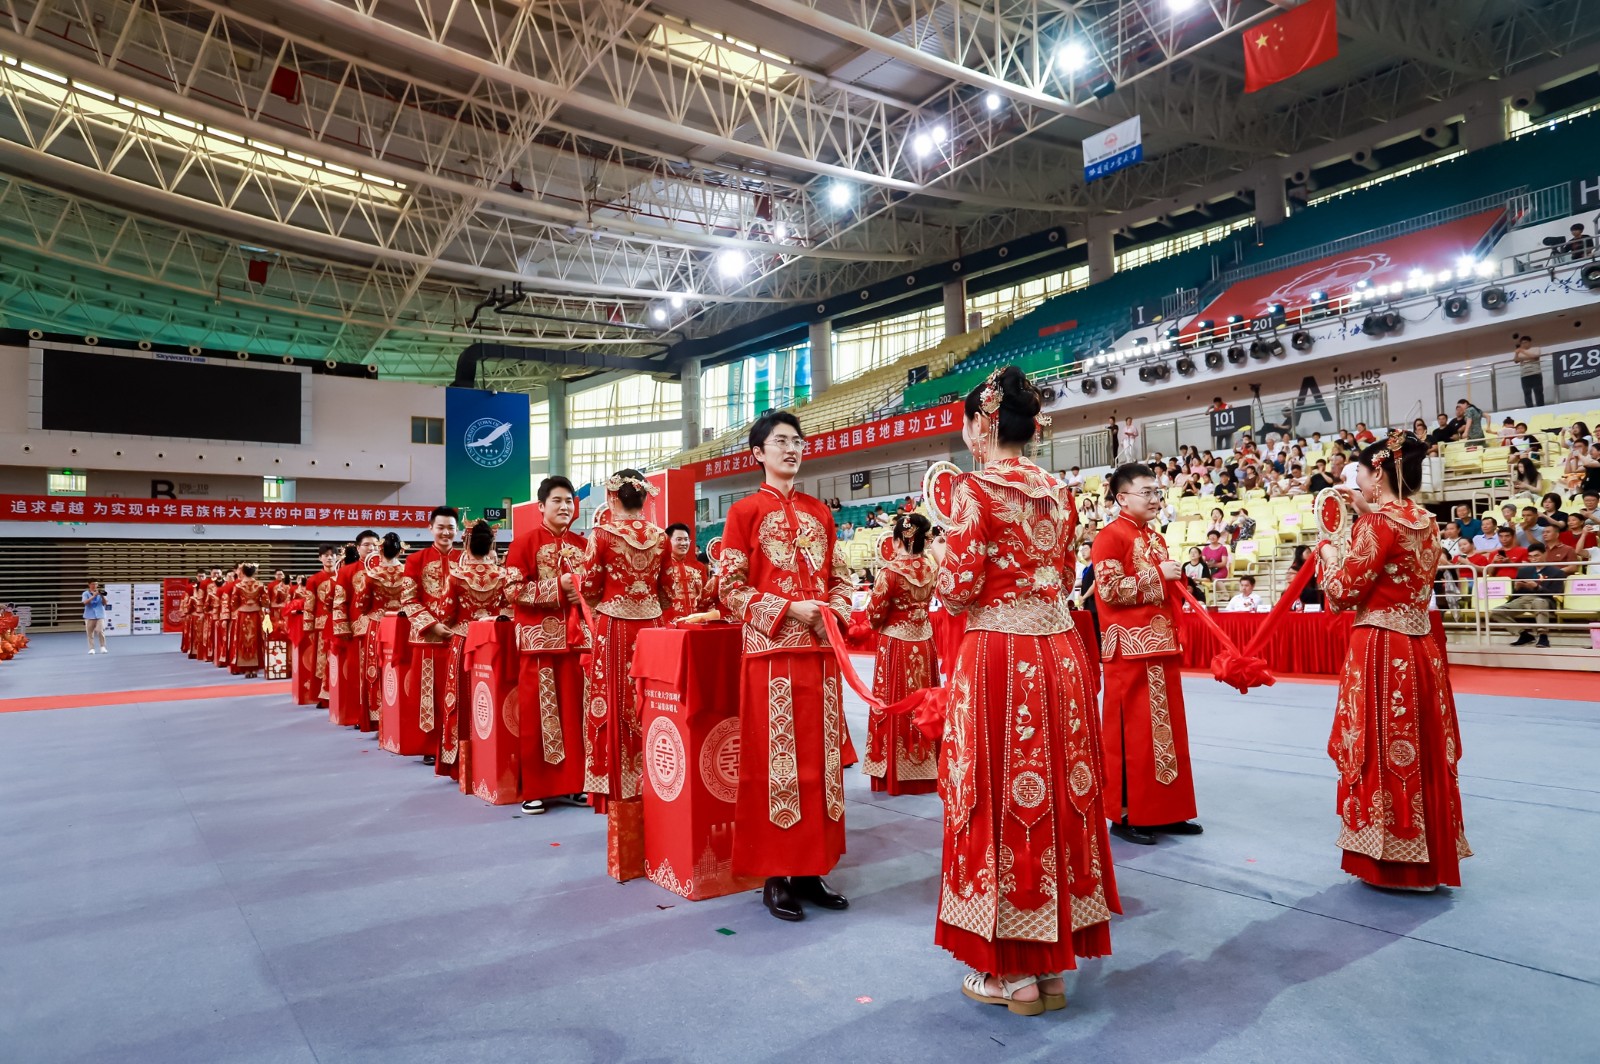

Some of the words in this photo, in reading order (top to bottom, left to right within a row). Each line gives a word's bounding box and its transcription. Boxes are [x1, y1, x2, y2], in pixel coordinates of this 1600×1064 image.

[1253, 317, 1272, 331] 201
[1559, 349, 1600, 371] 128
[1333, 368, 1381, 386] 101-105
[940, 394, 952, 405] 202
[1295, 376, 1333, 427] A
[1214, 410, 1235, 426] 101
[852, 473, 864, 484] 103
[151, 479, 177, 499] B
[10, 500, 85, 515] 追求卓越
[486, 509, 501, 517] 106
